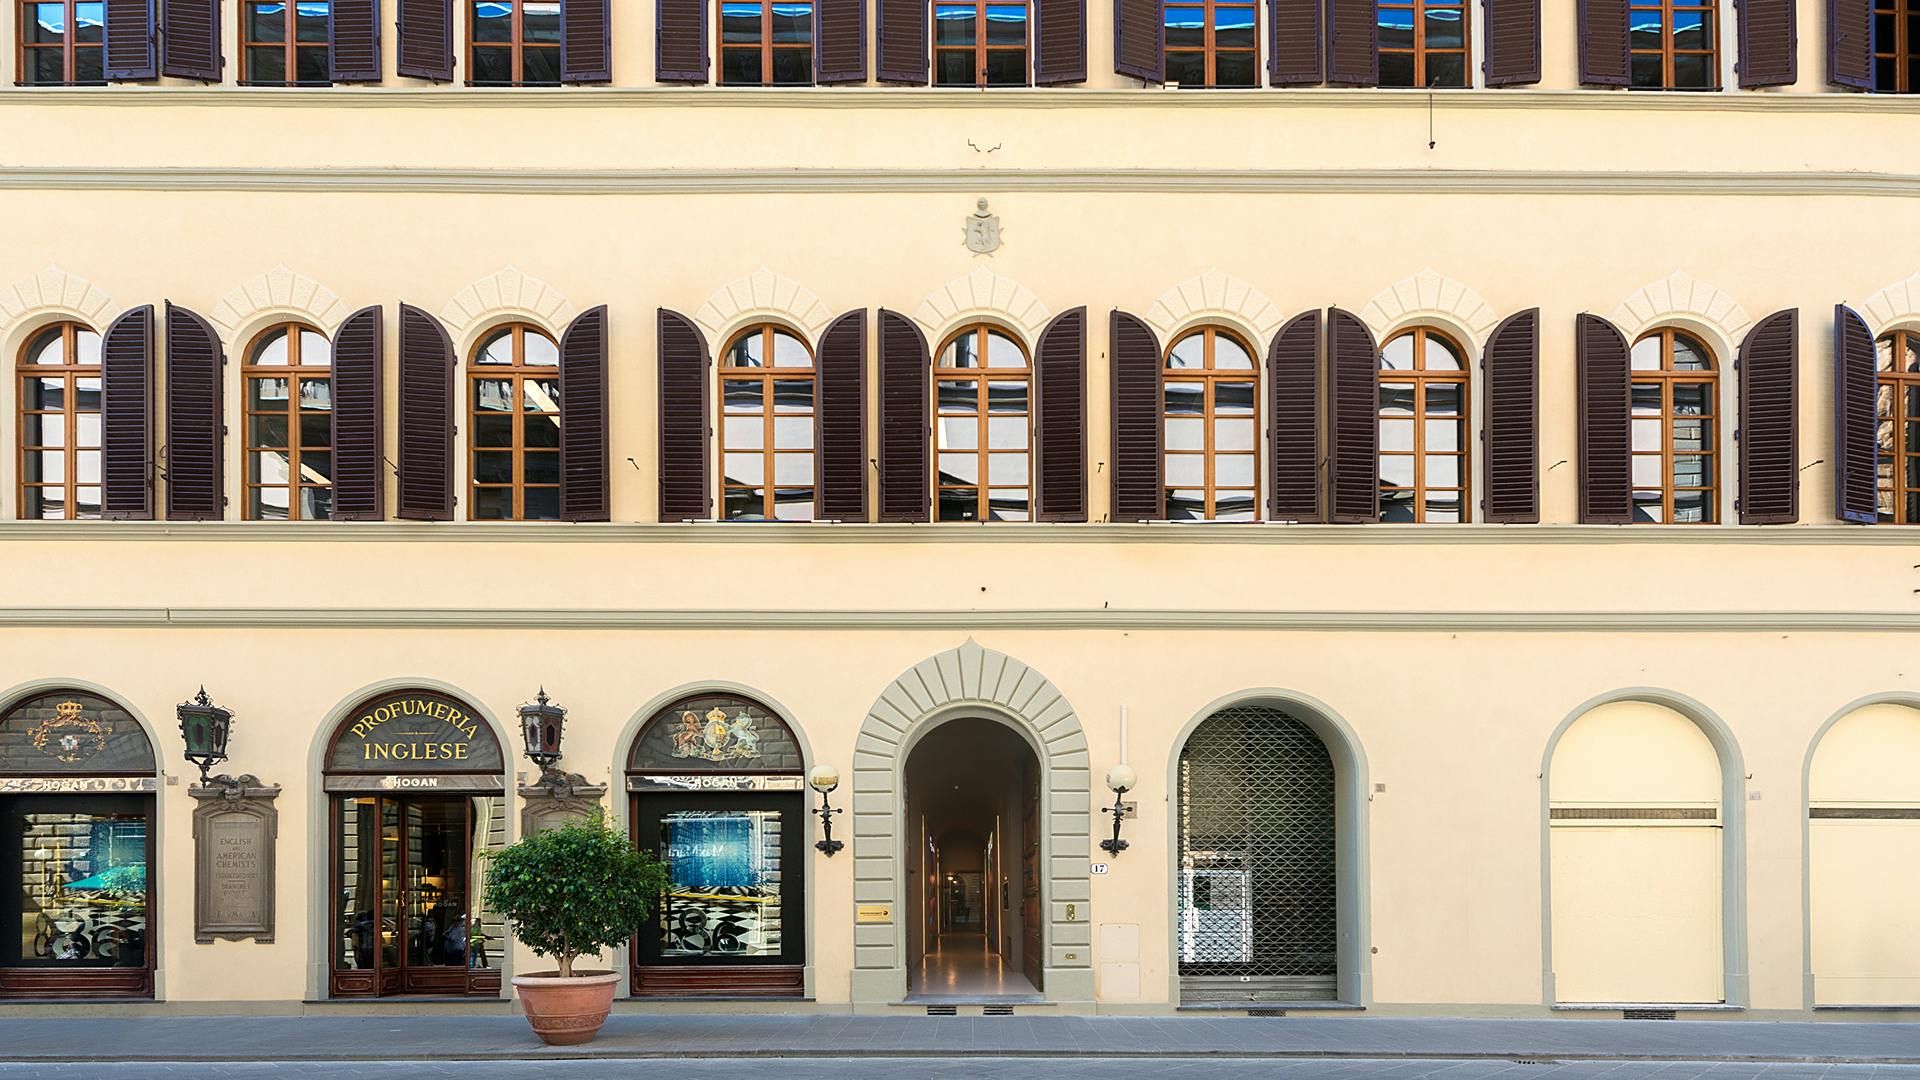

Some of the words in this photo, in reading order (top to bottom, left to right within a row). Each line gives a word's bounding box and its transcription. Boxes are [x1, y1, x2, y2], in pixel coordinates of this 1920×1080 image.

[351, 700, 478, 740] PROFUMERIA
[364, 743, 469, 760] INGLESE
[43, 780, 88, 790] HOGAN
[393, 778, 438, 787] HOGAN
[694, 778, 737, 788] HOGAN
[220, 838, 252, 846] ENGLISH
[216, 852, 257, 860] AMERICAN
